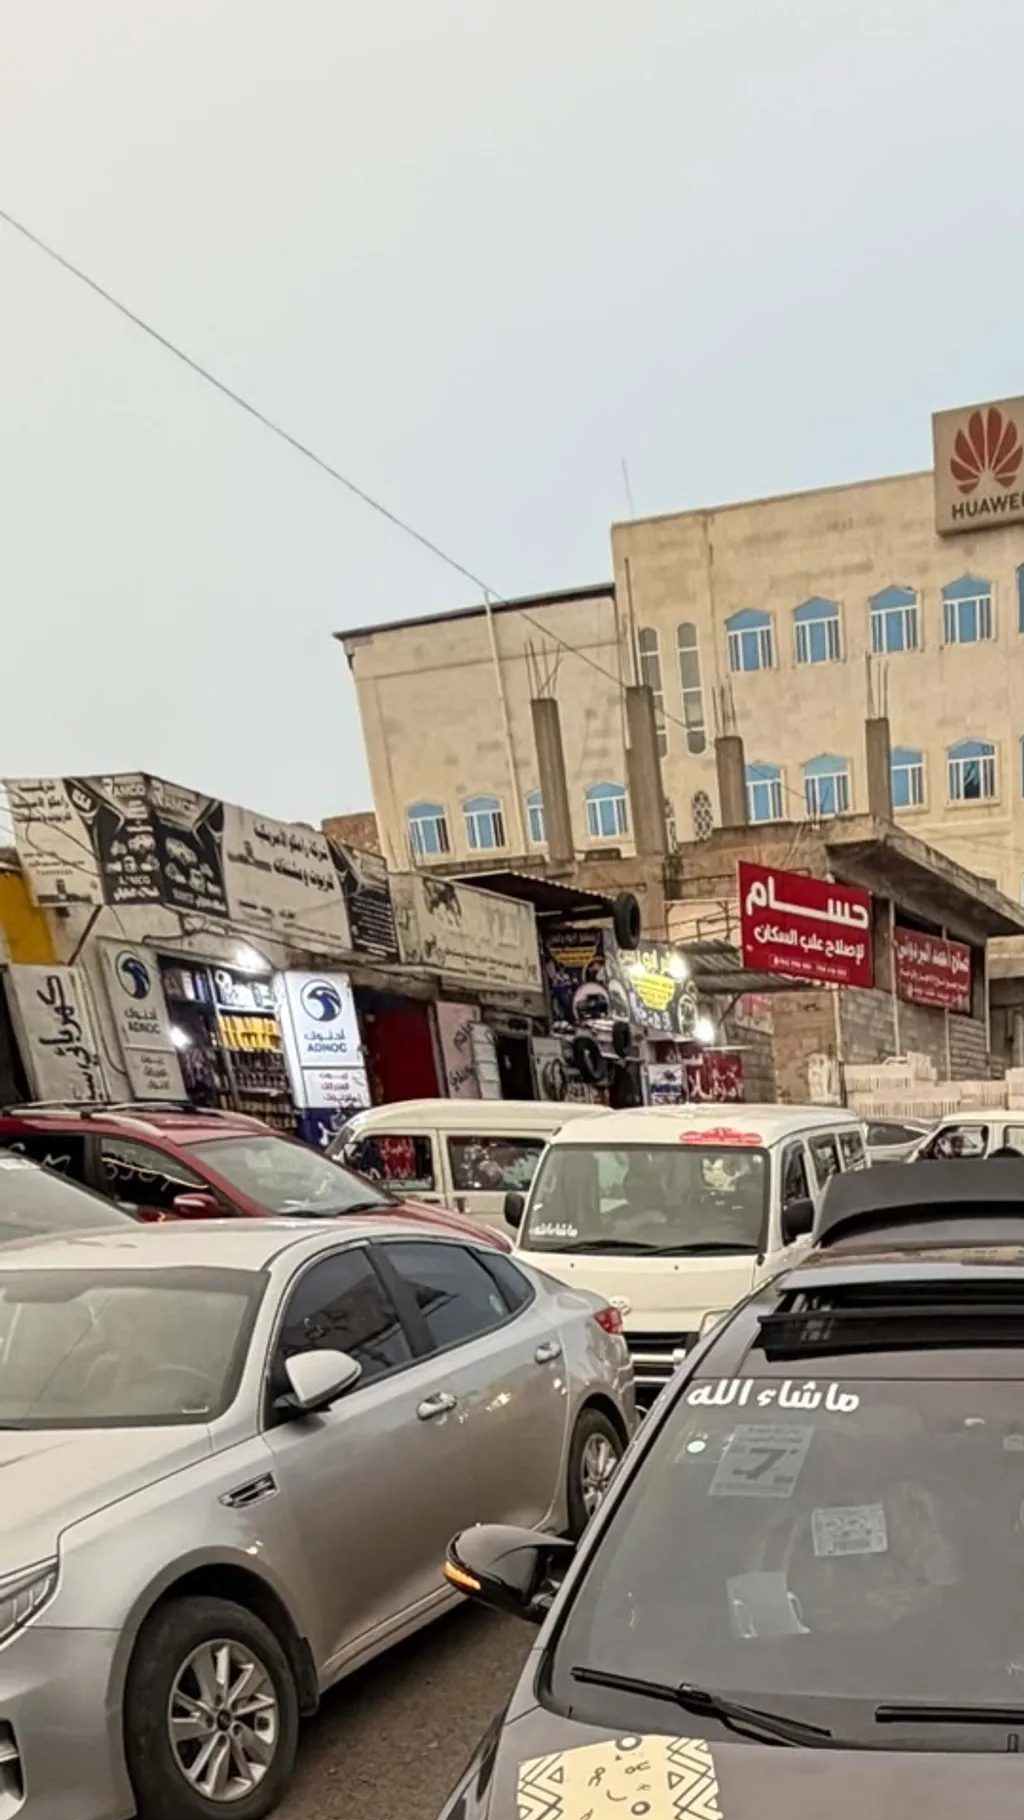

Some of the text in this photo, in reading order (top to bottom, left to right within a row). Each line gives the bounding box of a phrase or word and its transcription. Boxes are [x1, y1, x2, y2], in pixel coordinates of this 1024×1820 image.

[745, 876, 869, 929] حسام
[753, 923, 799, 946] السكان
[800, 933, 824, 954] علب
[307, 1042, 348, 1053] ADNOC
[687, 1379, 860, 1412] ماشاء الله
